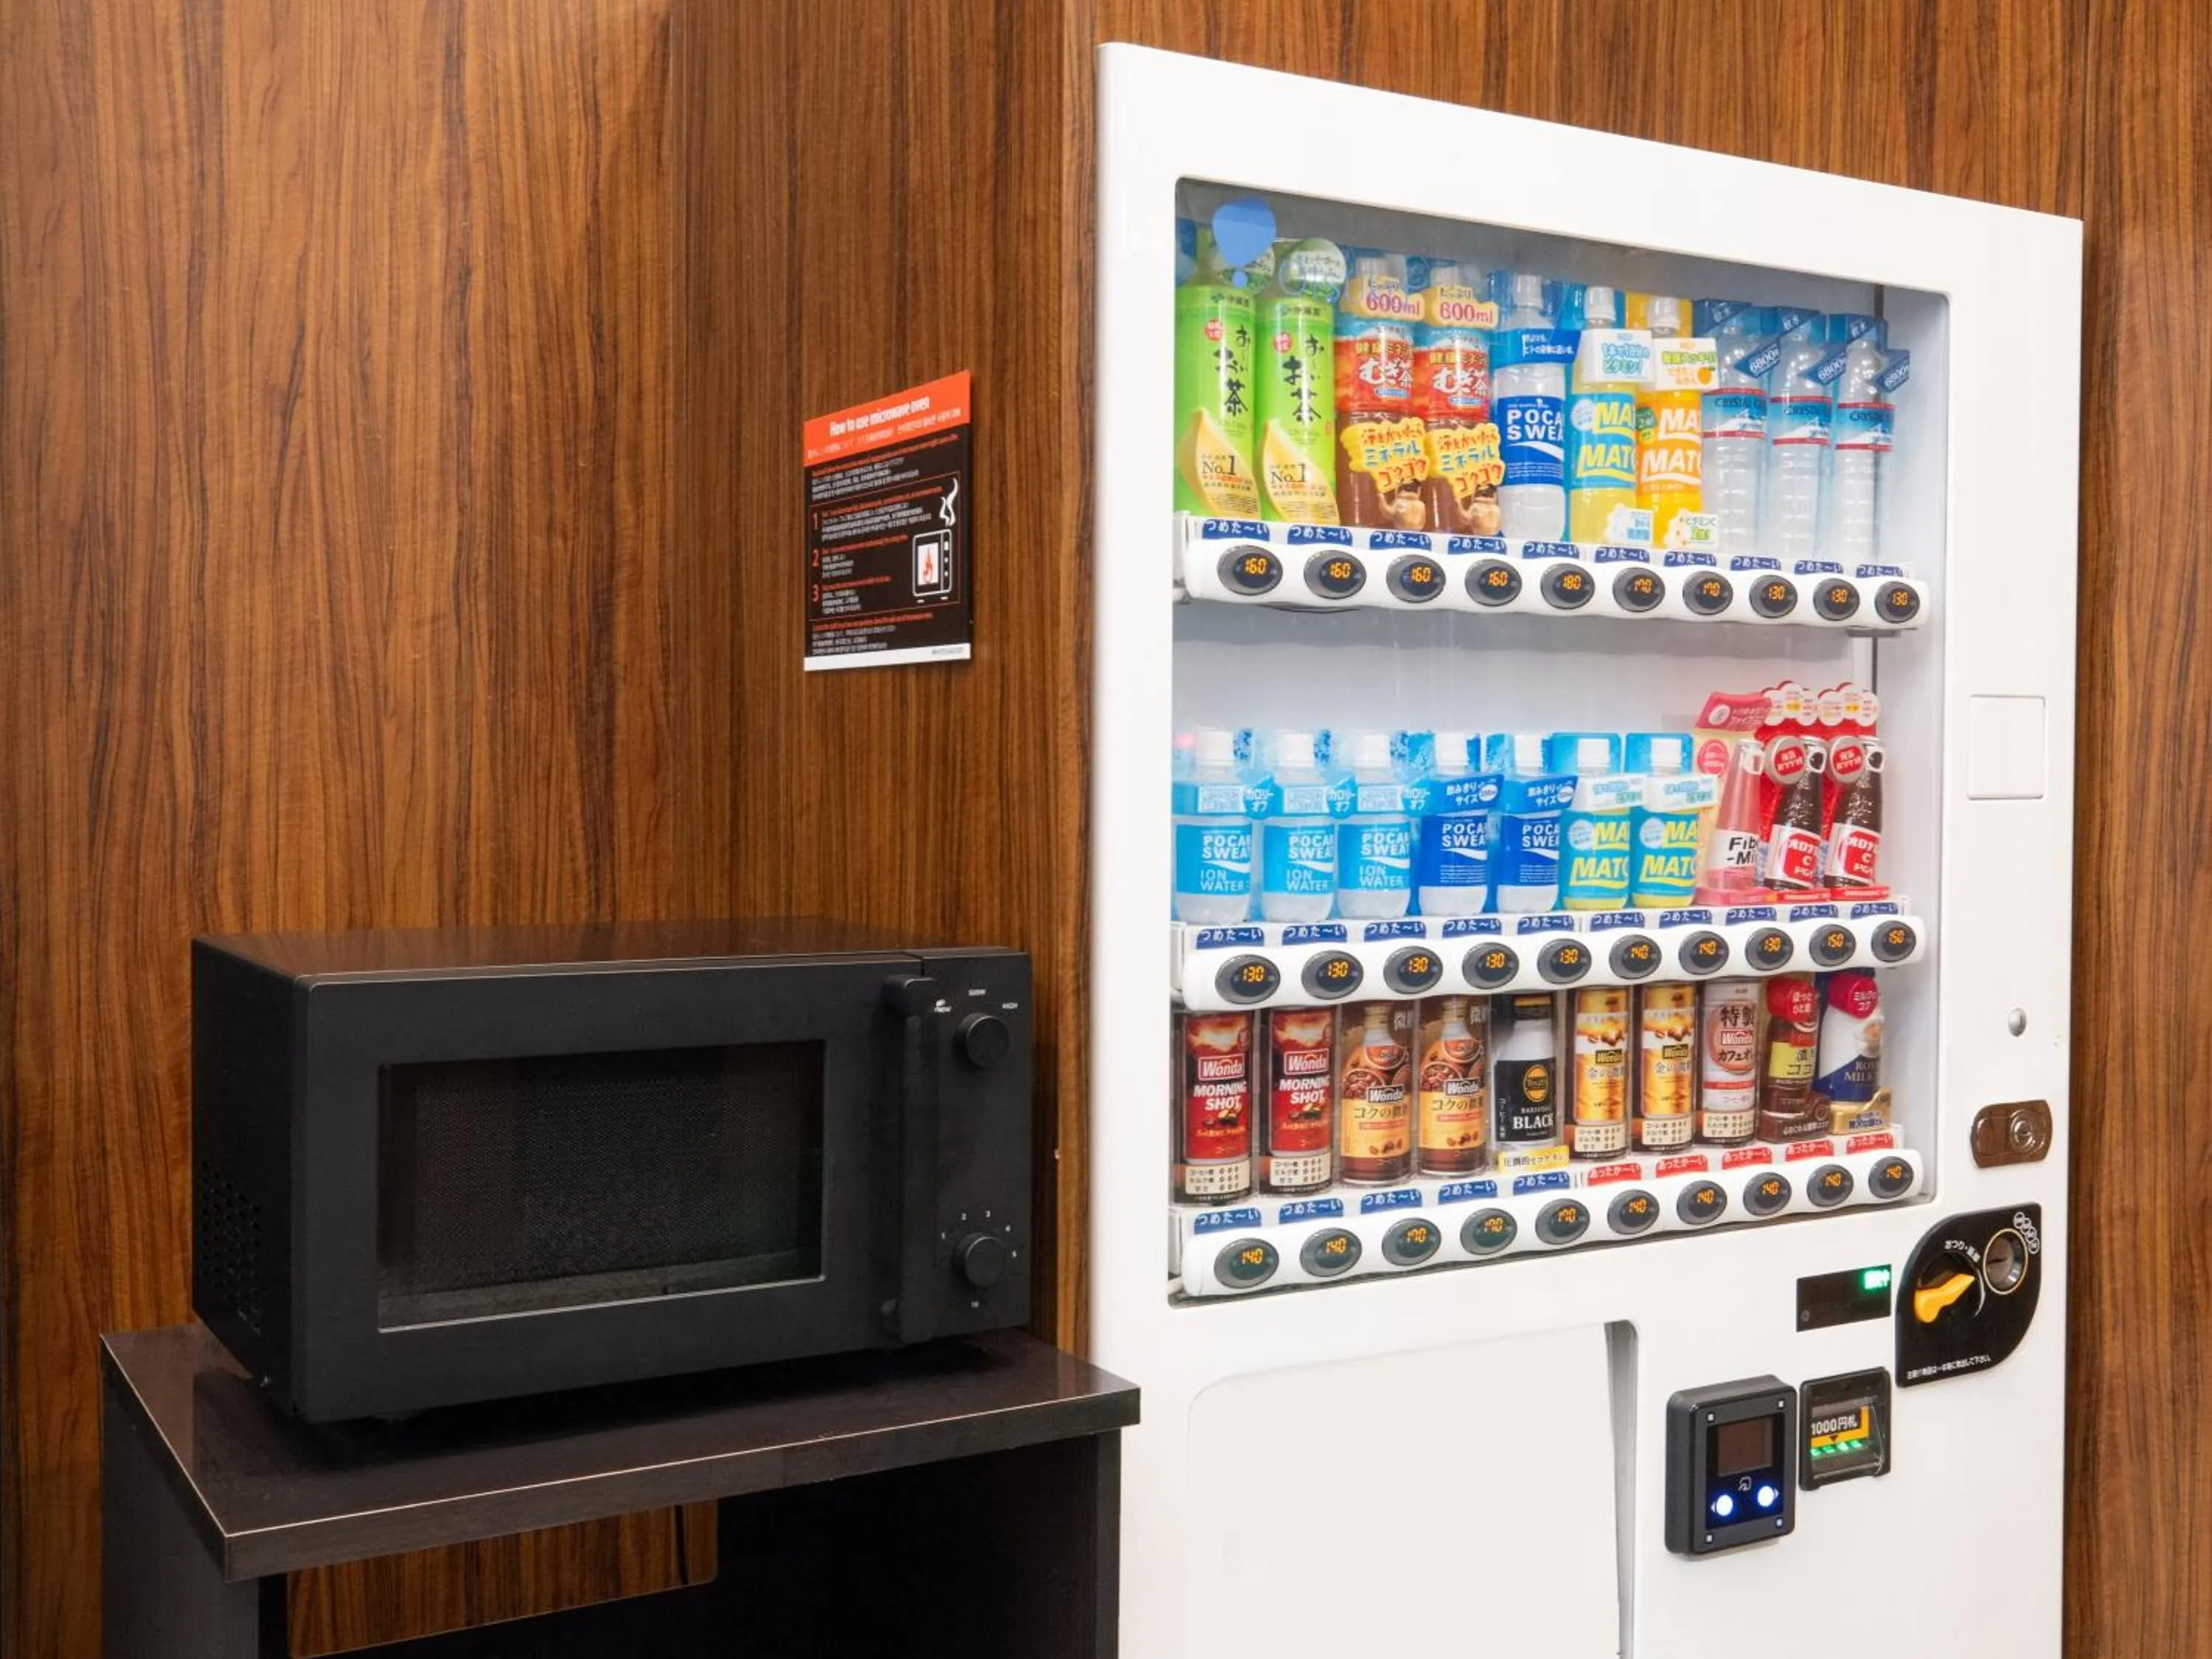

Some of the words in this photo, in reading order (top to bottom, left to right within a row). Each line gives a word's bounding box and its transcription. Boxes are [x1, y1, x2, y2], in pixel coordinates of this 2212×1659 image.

[1366, 293, 1420, 316] 600ml
[1440, 301, 1493, 324] 600ml
[829, 420, 846, 438] How
[856, 416, 869, 431] use
[869, 407, 911, 426] microwave
[911, 396, 931, 414] oven
[813, 548, 820, 568] 2
[1245, 557, 1267, 575] 160
[1329, 562, 1352, 580] 160
[1411, 566, 1431, 582] 160
[1488, 571, 1509, 587] 160
[1562, 574, 1582, 590] 180
[813, 583, 820, 602] 3
[1200, 869, 1227, 880] ION
[1286, 869, 1312, 880] ION
[1359, 865, 1387, 875] ION
[1199, 880, 1245, 891] WATER
[1285, 880, 1329, 891] WATER
[1359, 875, 1404, 887] WATER
[1486, 952, 1506, 968] 130
[1559, 948, 1579, 964] 130
[1328, 961, 1349, 978] 130
[1409, 957, 1428, 973] 130
[1242, 965, 1265, 982] 130
[1719, 1004, 1755, 1028] 特製
[1287, 1056, 1328, 1071] Wonda
[1718, 1048, 1754, 1063] カフェオ
[1202, 1061, 1243, 1077] Wonda
[1193, 1080, 1247, 1098] MORNING
[1279, 1075, 1330, 1092] MORNING
[1204, 1096, 1242, 1111] SHOT
[1290, 1091, 1325, 1105] SHOT
[1512, 1113, 1554, 1130] BLACK
[1326, 1237, 1347, 1253] 140
[1242, 1248, 1264, 1265] 140
